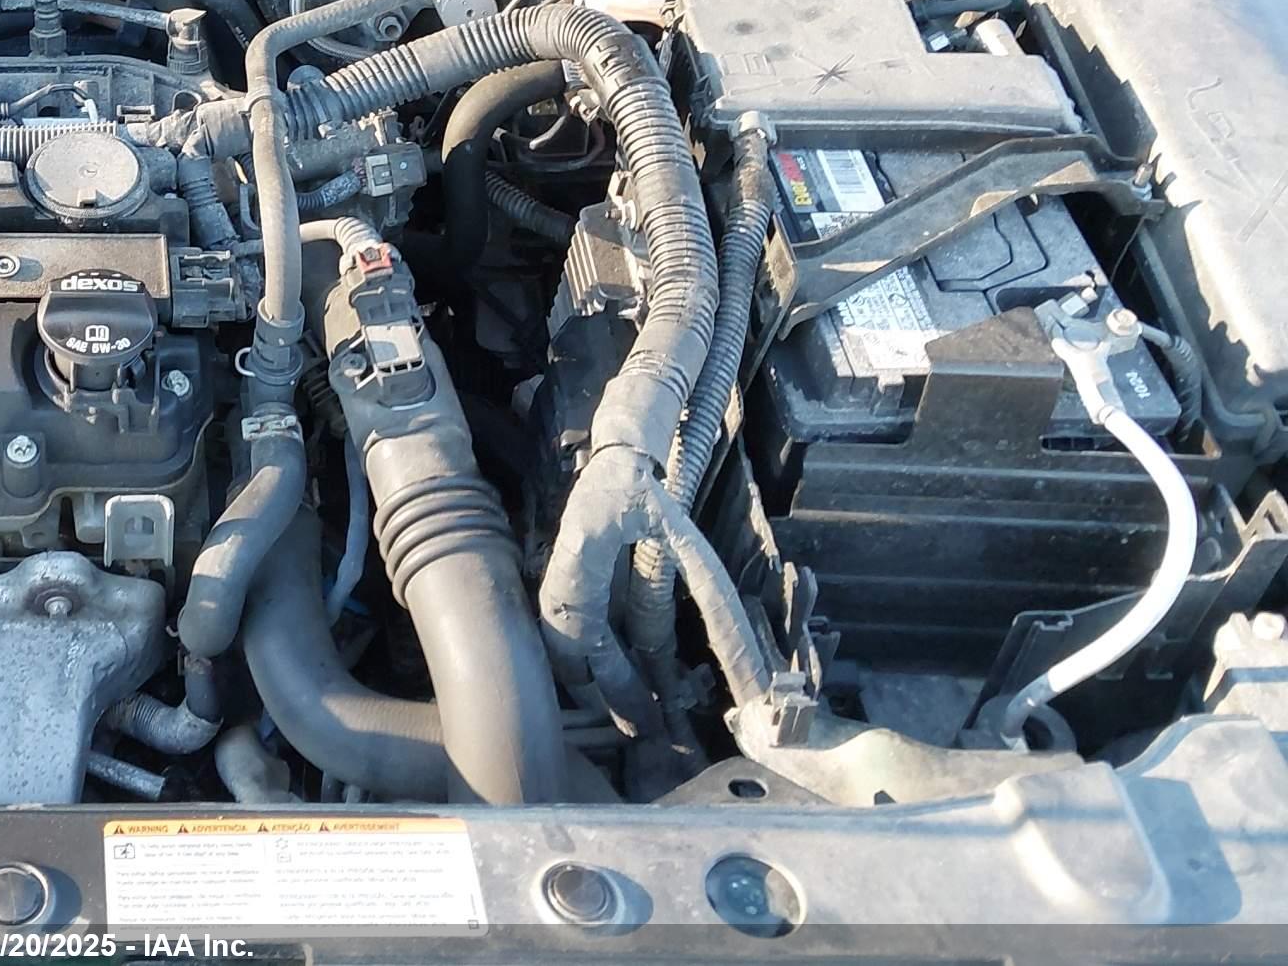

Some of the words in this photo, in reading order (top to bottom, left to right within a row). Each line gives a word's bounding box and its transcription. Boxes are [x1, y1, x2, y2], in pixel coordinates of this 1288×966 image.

[60, 276, 142, 292] dexos
[66, 337, 88, 353] SAE
[91, 337, 132, 354] 5W-30
[127, 825, 169, 834] WARNING
[333, 823, 399, 832] AVERTISSEMENT
